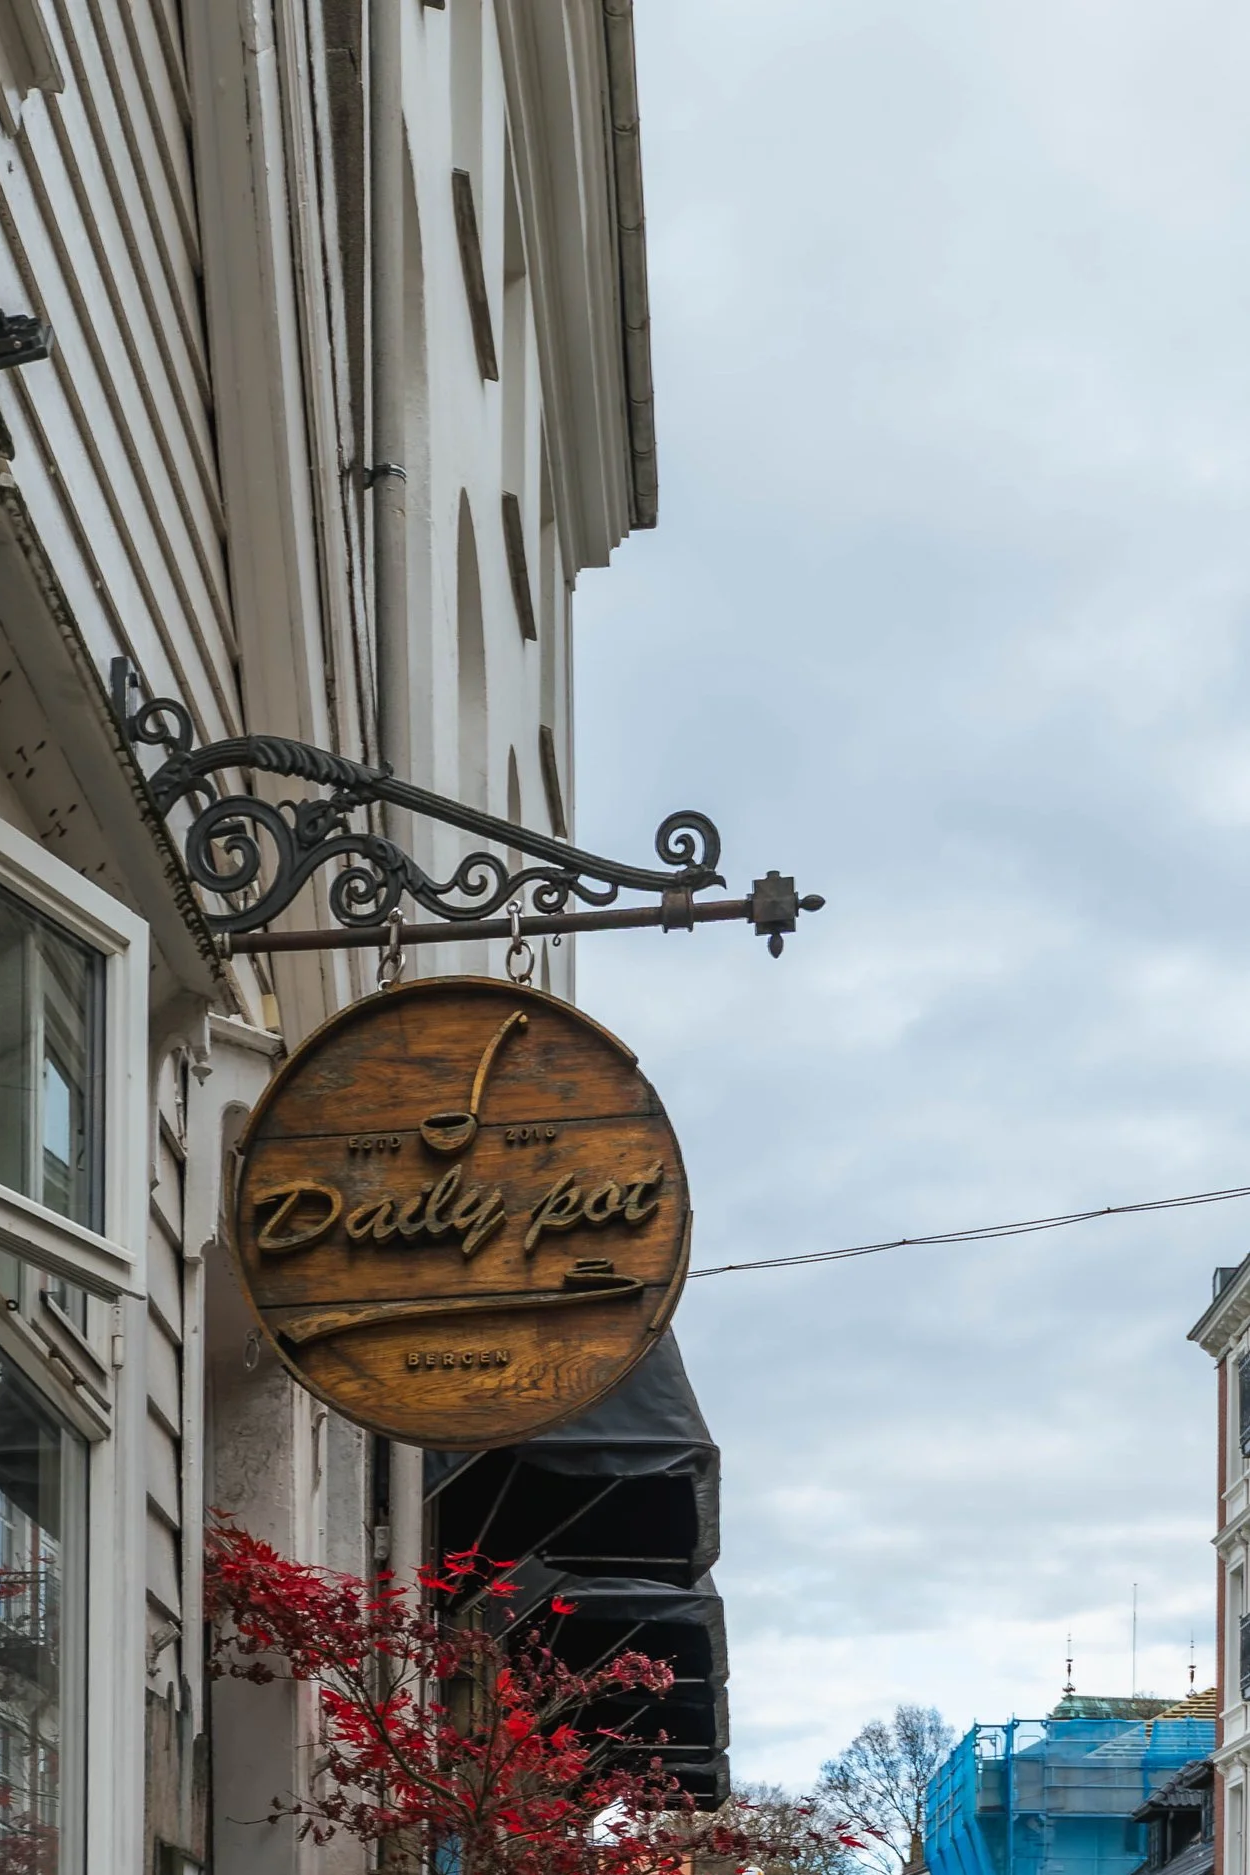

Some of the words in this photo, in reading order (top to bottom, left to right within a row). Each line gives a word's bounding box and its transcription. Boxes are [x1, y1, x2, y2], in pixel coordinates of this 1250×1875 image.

[348, 1136, 402, 1149] ESTD
[252, 1163, 507, 1255] Daily
[523, 1159, 664, 1251] pot
[407, 1350, 508, 1366] BERGEN
